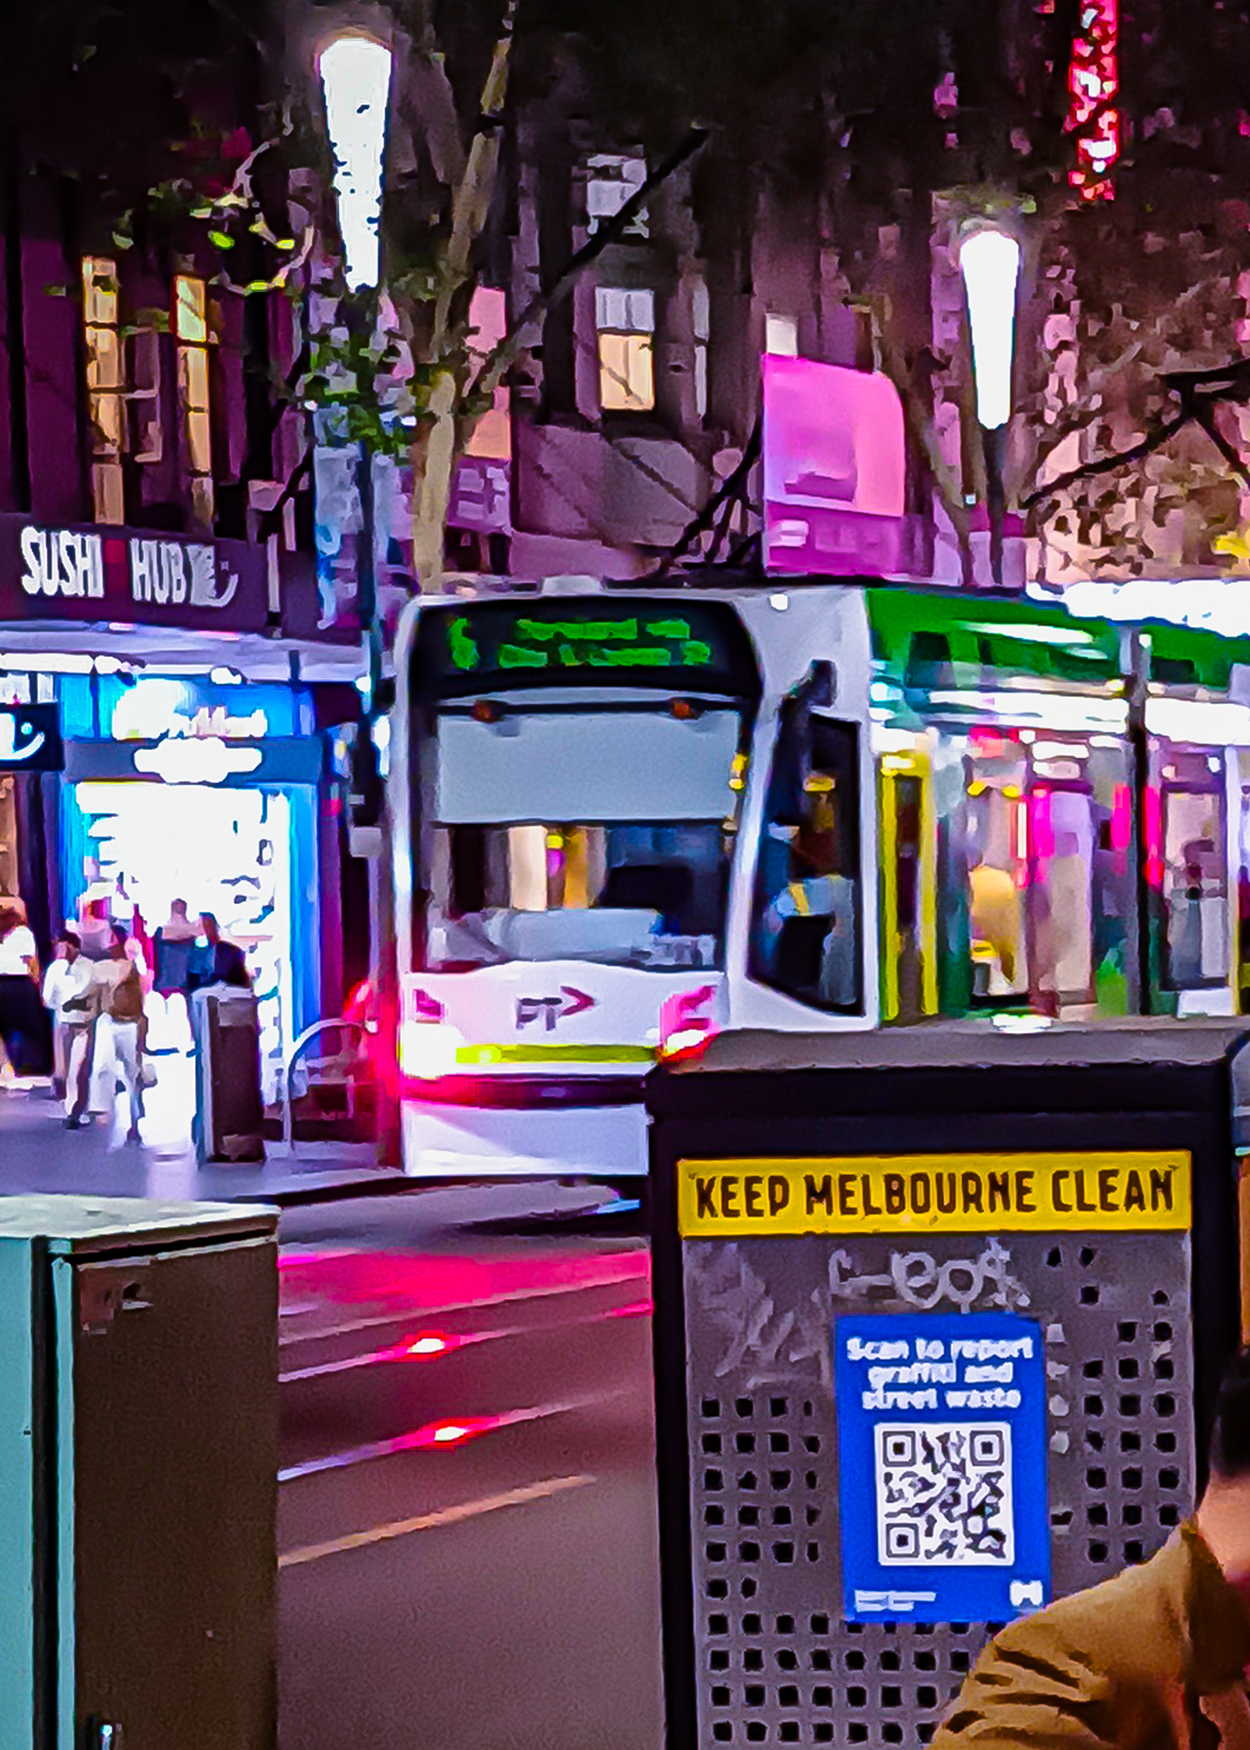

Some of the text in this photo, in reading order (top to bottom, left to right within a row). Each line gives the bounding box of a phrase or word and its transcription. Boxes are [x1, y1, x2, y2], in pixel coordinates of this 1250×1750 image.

[20, 526, 187, 604] SUSHI HUB
[696, 1168, 1175, 1219] KEEP MELBOURNE CLEAN
[847, 1336, 1034, 1362] Scan to report
